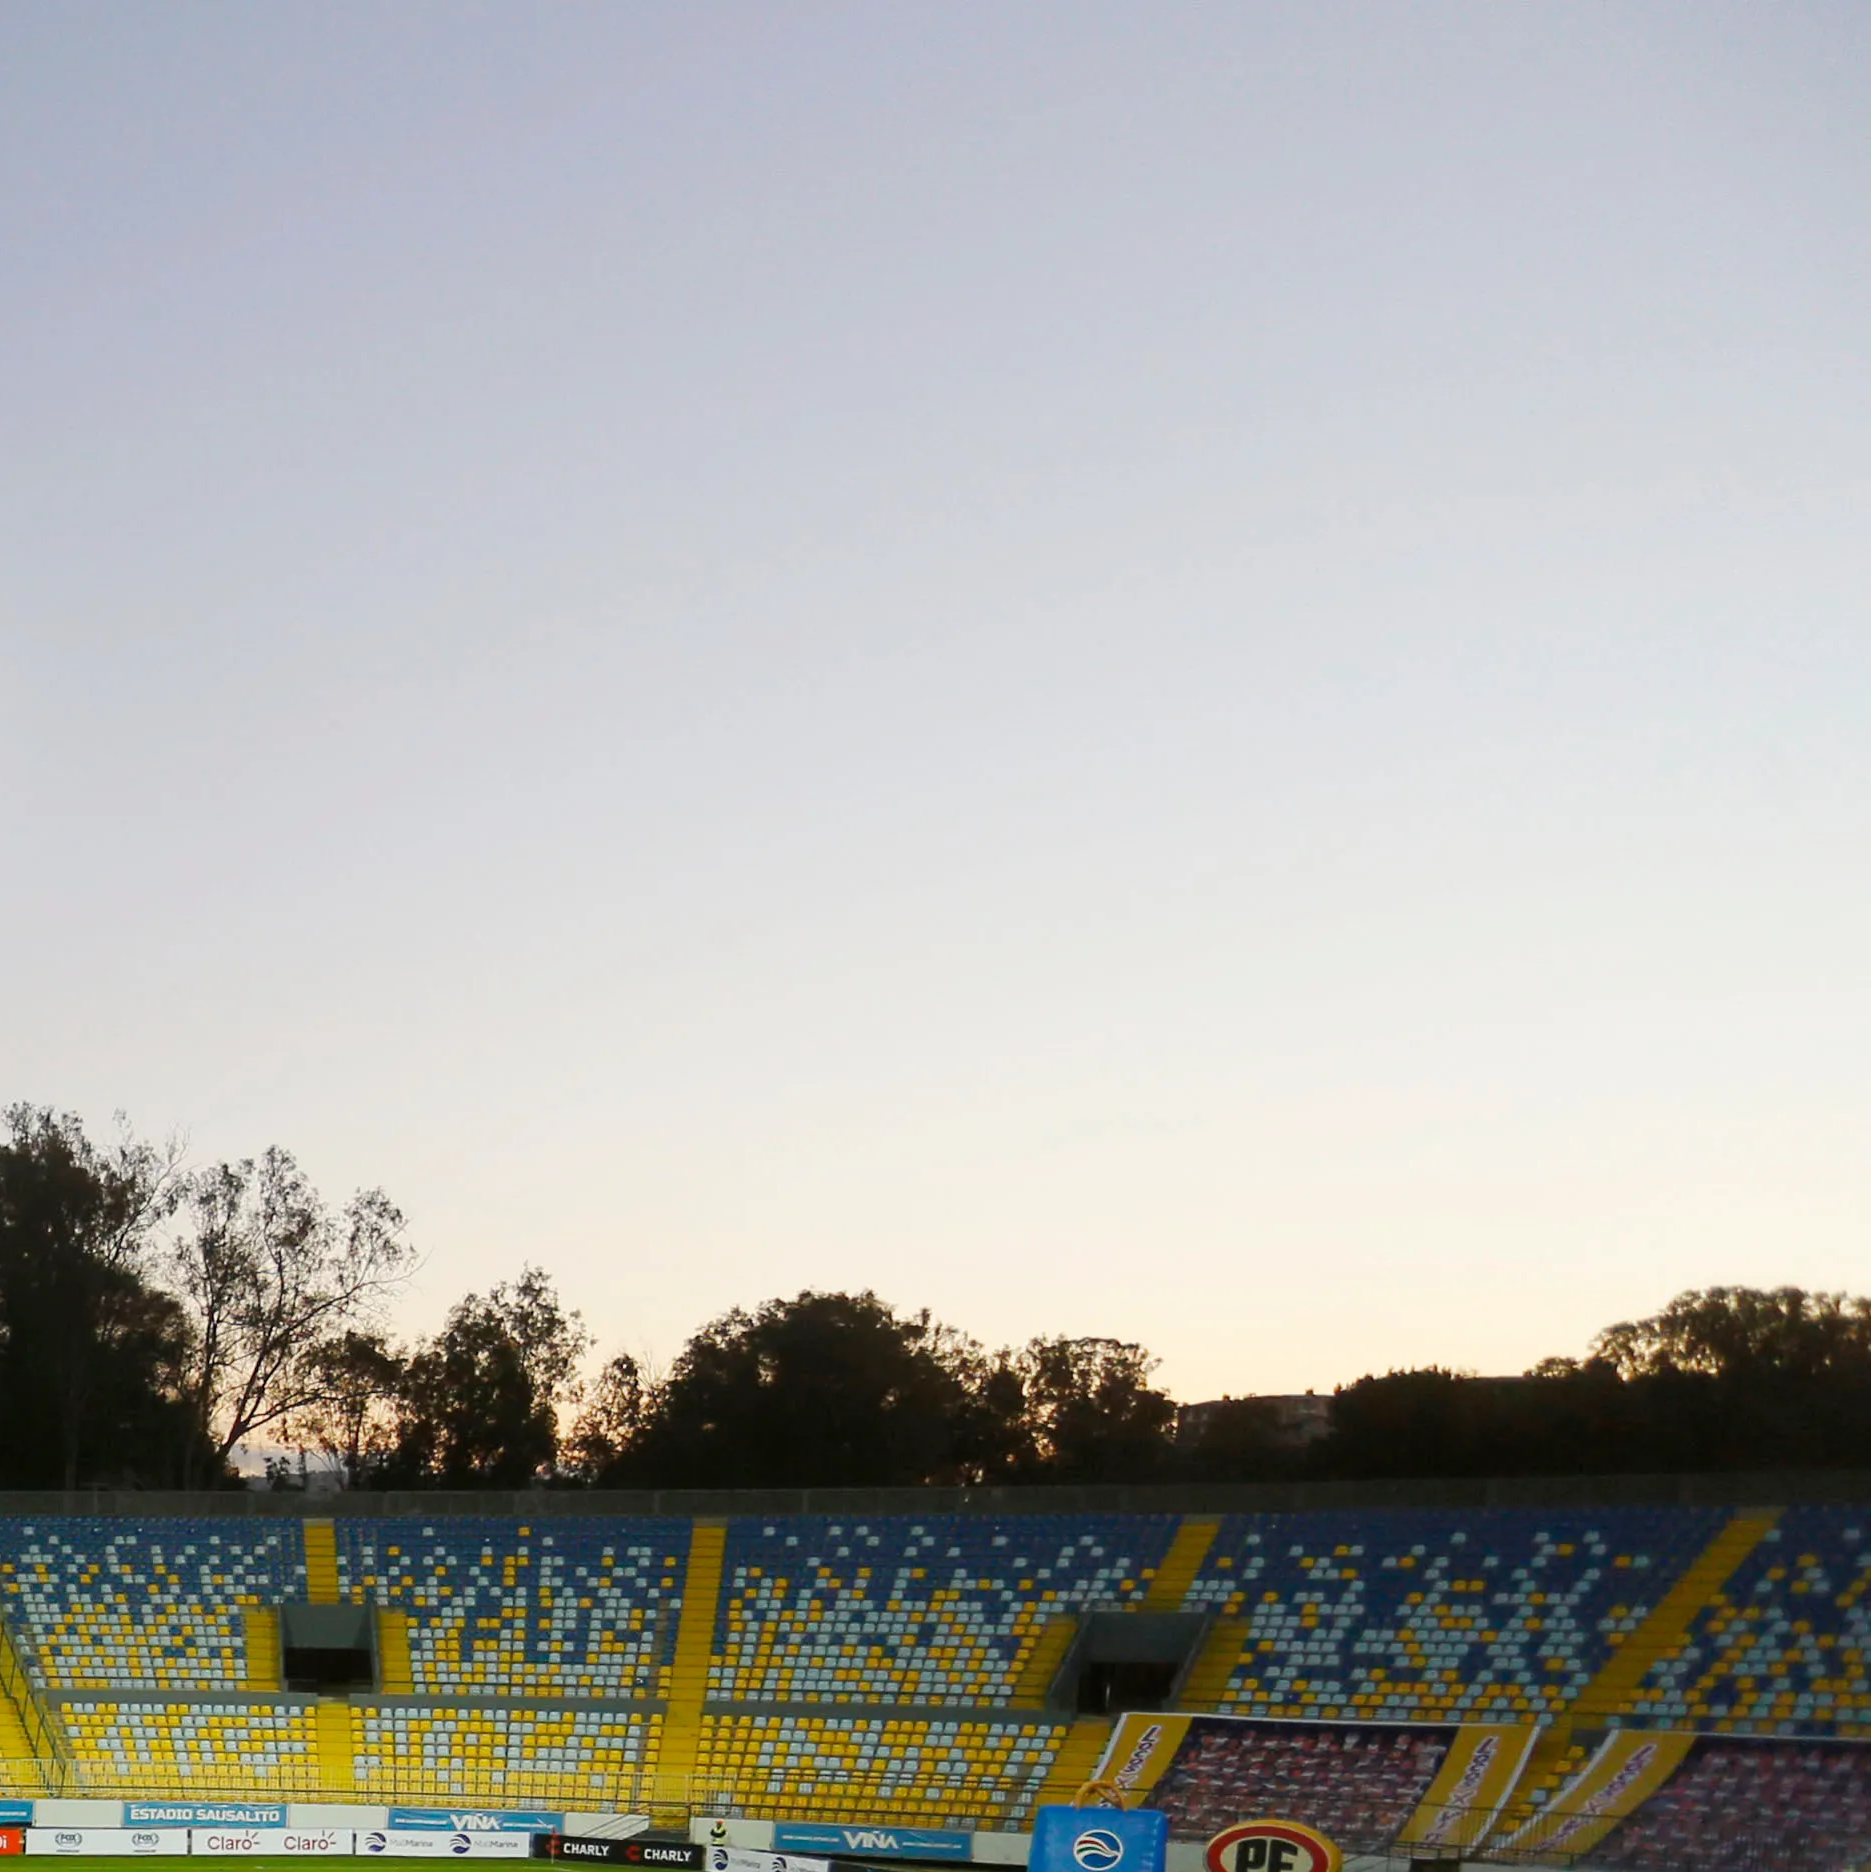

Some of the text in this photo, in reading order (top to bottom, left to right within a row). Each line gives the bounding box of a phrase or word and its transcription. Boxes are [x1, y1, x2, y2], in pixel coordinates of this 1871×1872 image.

[129, 1808, 280, 1823] ESTADIO SAUSALITO
[449, 1813, 501, 1831] VIÑA
[207, 1836, 252, 1850] Claro
[283, 1836, 329, 1850] Claro
[842, 1830, 899, 1850] VIÑA
[562, 1842, 609, 1858] CHARLY
[643, 1847, 692, 1863] CHARLY
